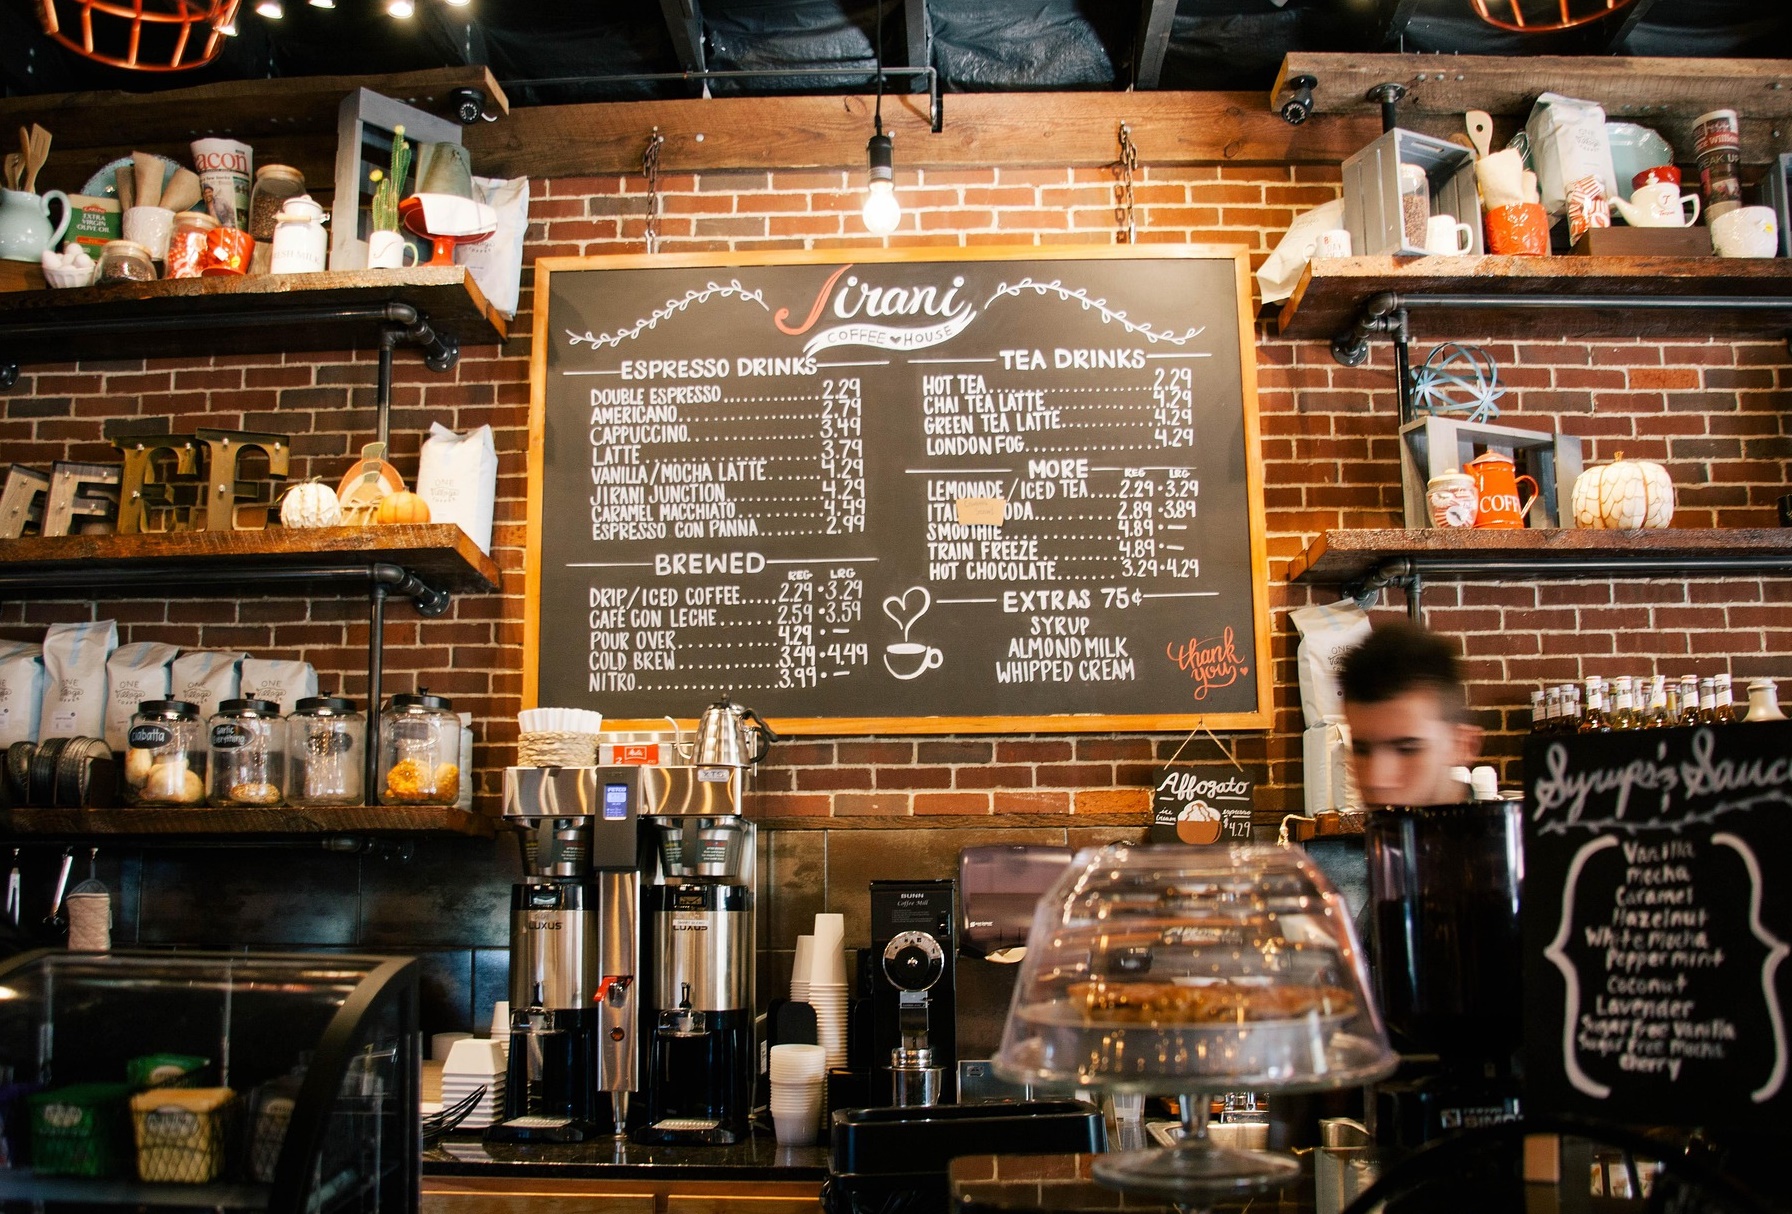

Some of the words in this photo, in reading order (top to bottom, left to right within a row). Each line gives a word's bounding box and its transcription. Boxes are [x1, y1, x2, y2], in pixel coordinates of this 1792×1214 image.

[775, 263, 964, 335] Jirani
[828, 327, 888, 345] COFFEE
[903, 326, 953, 347] HOUSE
[621, 359, 729, 379] ESPRESSO
[738, 357, 817, 377] DRINKS
[999, 351, 1047, 370] TEA
[1054, 349, 1146, 369] DRINKS
[591, 388, 644, 406] DOUBLE
[650, 386, 721, 404] ESPRESSO
[823, 378, 861, 400] 2.29
[923, 375, 953, 395] HOT
[958, 375, 987, 394] TEA
[1154, 369, 1191, 390] 2.29
[591, 406, 677, 424] AMERICANO
[821, 399, 861, 419] 2.79
[923, 396, 960, 415] CHAI
[965, 395, 995, 414] TEA
[999, 392, 1045, 412] LATTE
[1153, 390, 1191, 410] 4.29
[590, 425, 688, 445] CAPPUCCINO
[820, 418, 861, 438] 3.49
[924, 415, 973, 435] GREEN
[980, 413, 1009, 433] TEA
[1016, 411, 1061, 430] LATTE
[1154, 408, 1192, 428] 4.29
[592, 445, 641, 466] LATTE
[821, 439, 862, 459] 3.79
[926, 436, 992, 456] LONDON
[995, 435, 1024, 453] FOG
[1155, 429, 1194, 447] 4.29
[718, 462, 767, 481] LATTE
[821, 459, 863, 480] 4.29
[1028, 459, 1088, 478] MORE
[1124, 468, 1146, 478] REG
[1169, 468, 1190, 478] LRG
[590, 486, 644, 506] JIRANI
[649, 484, 725, 503] JUNCTION
[822, 479, 865, 500] 4.29
[1060, 480, 1088, 498] TEA
[1119, 479, 1153, 498] 2.29
[1165, 480, 1199, 497] 3.29
[592, 504, 653, 523] CARAMEL
[659, 502, 735, 522] MACCHIATO
[824, 499, 865, 517] 4.49
[1003, 502, 1034, 521] ODA
[1117, 501, 1152, 520] 2.89
[1164, 501, 1197, 518] 3.89
[592, 523, 666, 540] ESPRESSO
[675, 522, 704, 538] CON
[709, 519, 758, 538] PANNA
[827, 516, 865, 535] 2.99
[927, 522, 1002, 541] SMOOTHIE
[1119, 521, 1154, 539] 4.89
[928, 542, 973, 560] TRAIN
[981, 540, 1038, 560] FREEZE
[1119, 540, 1155, 558] 4.89
[655, 553, 766, 576] BREWED
[788, 570, 813, 580] REG
[830, 569, 856, 579] LRG
[929, 563, 959, 581] HOT
[966, 562, 1056, 581] CHOCOLATE
[1122, 560, 1157, 577] 3.29
[1166, 559, 1199, 578] 4.29
[686, 586, 740, 606] COFFEE
[778, 582, 813, 603] 2.29
[825, 580, 862, 600] 3.29
[1003, 590, 1091, 612] EXTRAS
[1101, 588, 1143, 609] 75¢
[631, 610, 661, 628] CON
[670, 608, 717, 627] LECHE
[777, 604, 813, 624] 2.59
[825, 601, 861, 622] 3.59
[1030, 616, 1090, 636] SYRUP
[590, 631, 628, 650] POUR
[636, 630, 675, 650] OVER
[778, 625, 812, 646] 4.29
[1009, 638, 1082, 659] ALMOND
[1085, 637, 1128, 658] MILK
[1167, 626, 1246, 673] thank
[589, 651, 627, 671] COLD
[633, 651, 675, 671] BREW
[779, 645, 816, 668] 3.49
[827, 644, 868, 666] 4.49
[589, 673, 636, 692] NITRO
[779, 666, 817, 688] 3.99
[996, 661, 1073, 684] WHIPPED
[1079, 659, 1135, 682] CREAM
[1190, 662, 1238, 700] you
[119, 680, 140, 688] ONE
[1156, 772, 1250, 800] Affogato
[528, 921, 562, 930] LUXUS
